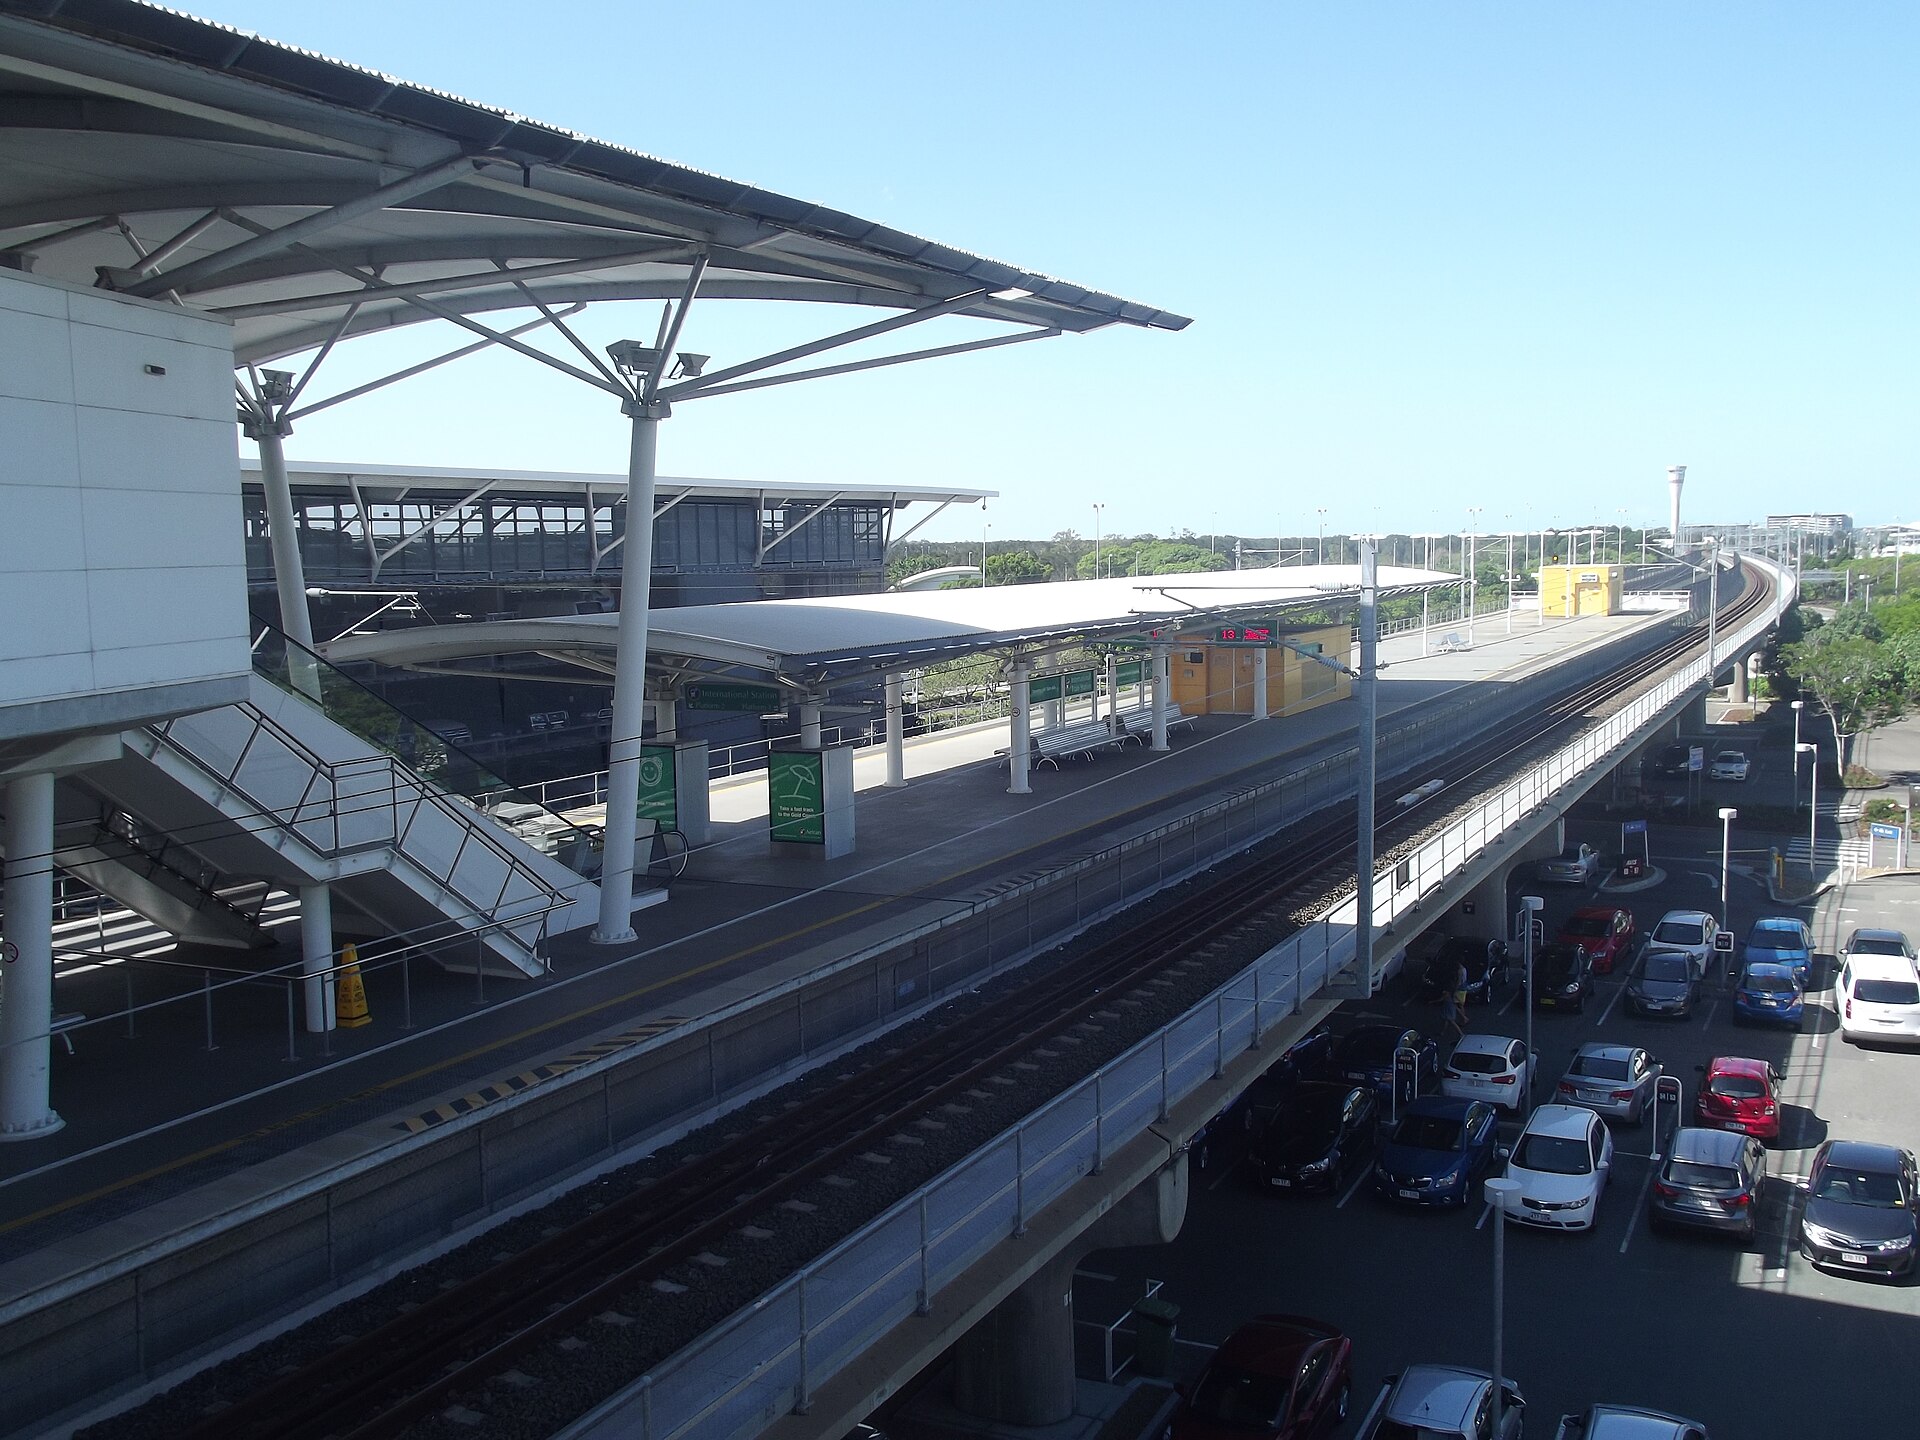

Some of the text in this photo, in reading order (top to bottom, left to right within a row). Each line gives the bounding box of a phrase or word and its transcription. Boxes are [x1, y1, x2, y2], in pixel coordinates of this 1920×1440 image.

[1222, 629, 1235, 639] 13
[701, 689, 777, 700] International Station
